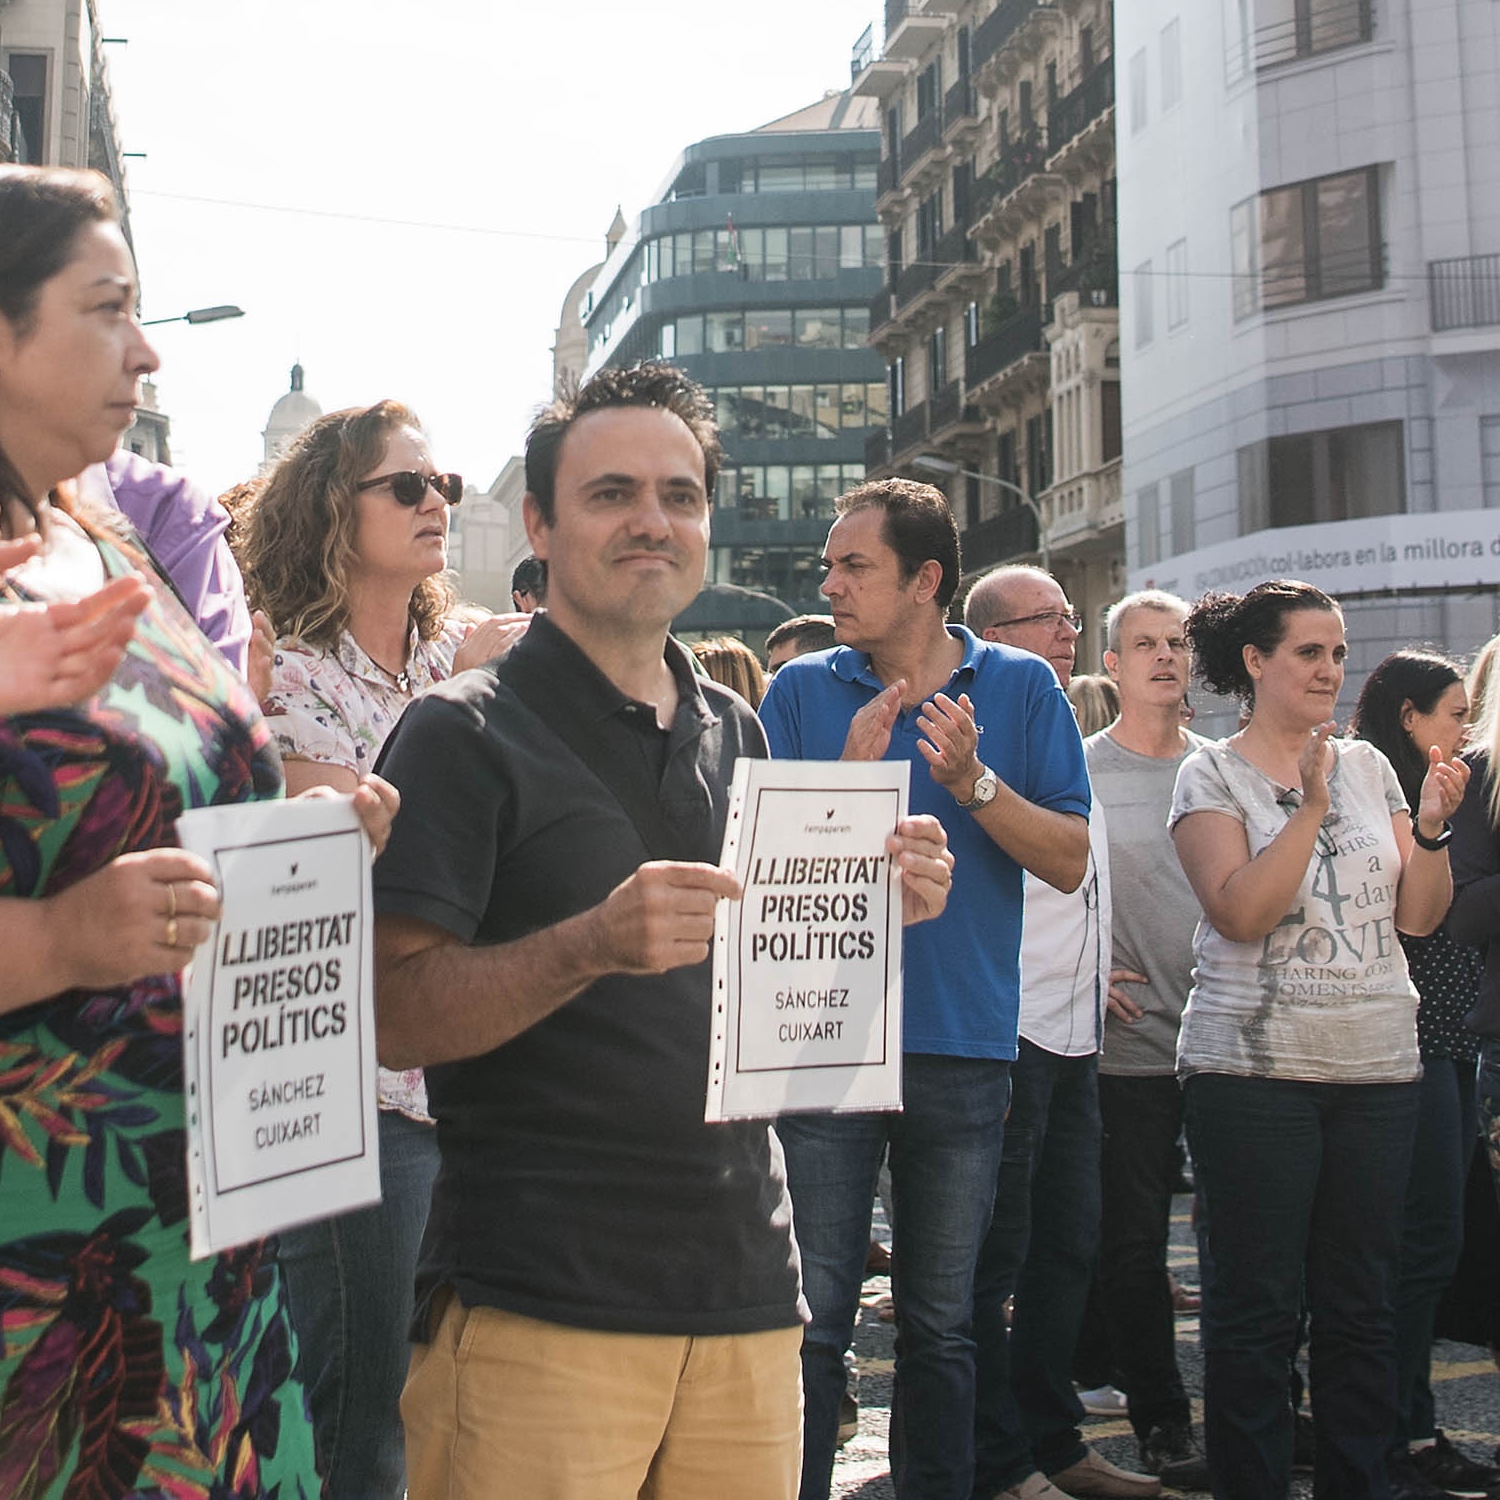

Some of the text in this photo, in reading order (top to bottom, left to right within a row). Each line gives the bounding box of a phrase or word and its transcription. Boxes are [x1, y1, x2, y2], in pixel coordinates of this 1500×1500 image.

[1355, 547, 1376, 565] en
[1381, 542, 1397, 562] la
[1404, 536, 1484, 561] millora
[1338, 832, 1380, 858] HRS
[752, 856, 885, 886] LLIBERTAT
[1368, 855, 1382, 874] a
[760, 892, 869, 924] PRESOS
[221, 911, 357, 968] LLIBERTAT
[751, 925, 876, 963] POLÍTICS
[1261, 915, 1394, 968] LOVE
[232, 957, 342, 1011] PRESOS
[1272, 966, 1358, 981] HARING
[1278, 982, 1368, 998] OMENTS
[221, 1002, 347, 1060] POLÍTICS
[778, 1021, 844, 1043] CUIXART
[255, 1112, 322, 1150] CUIXART
